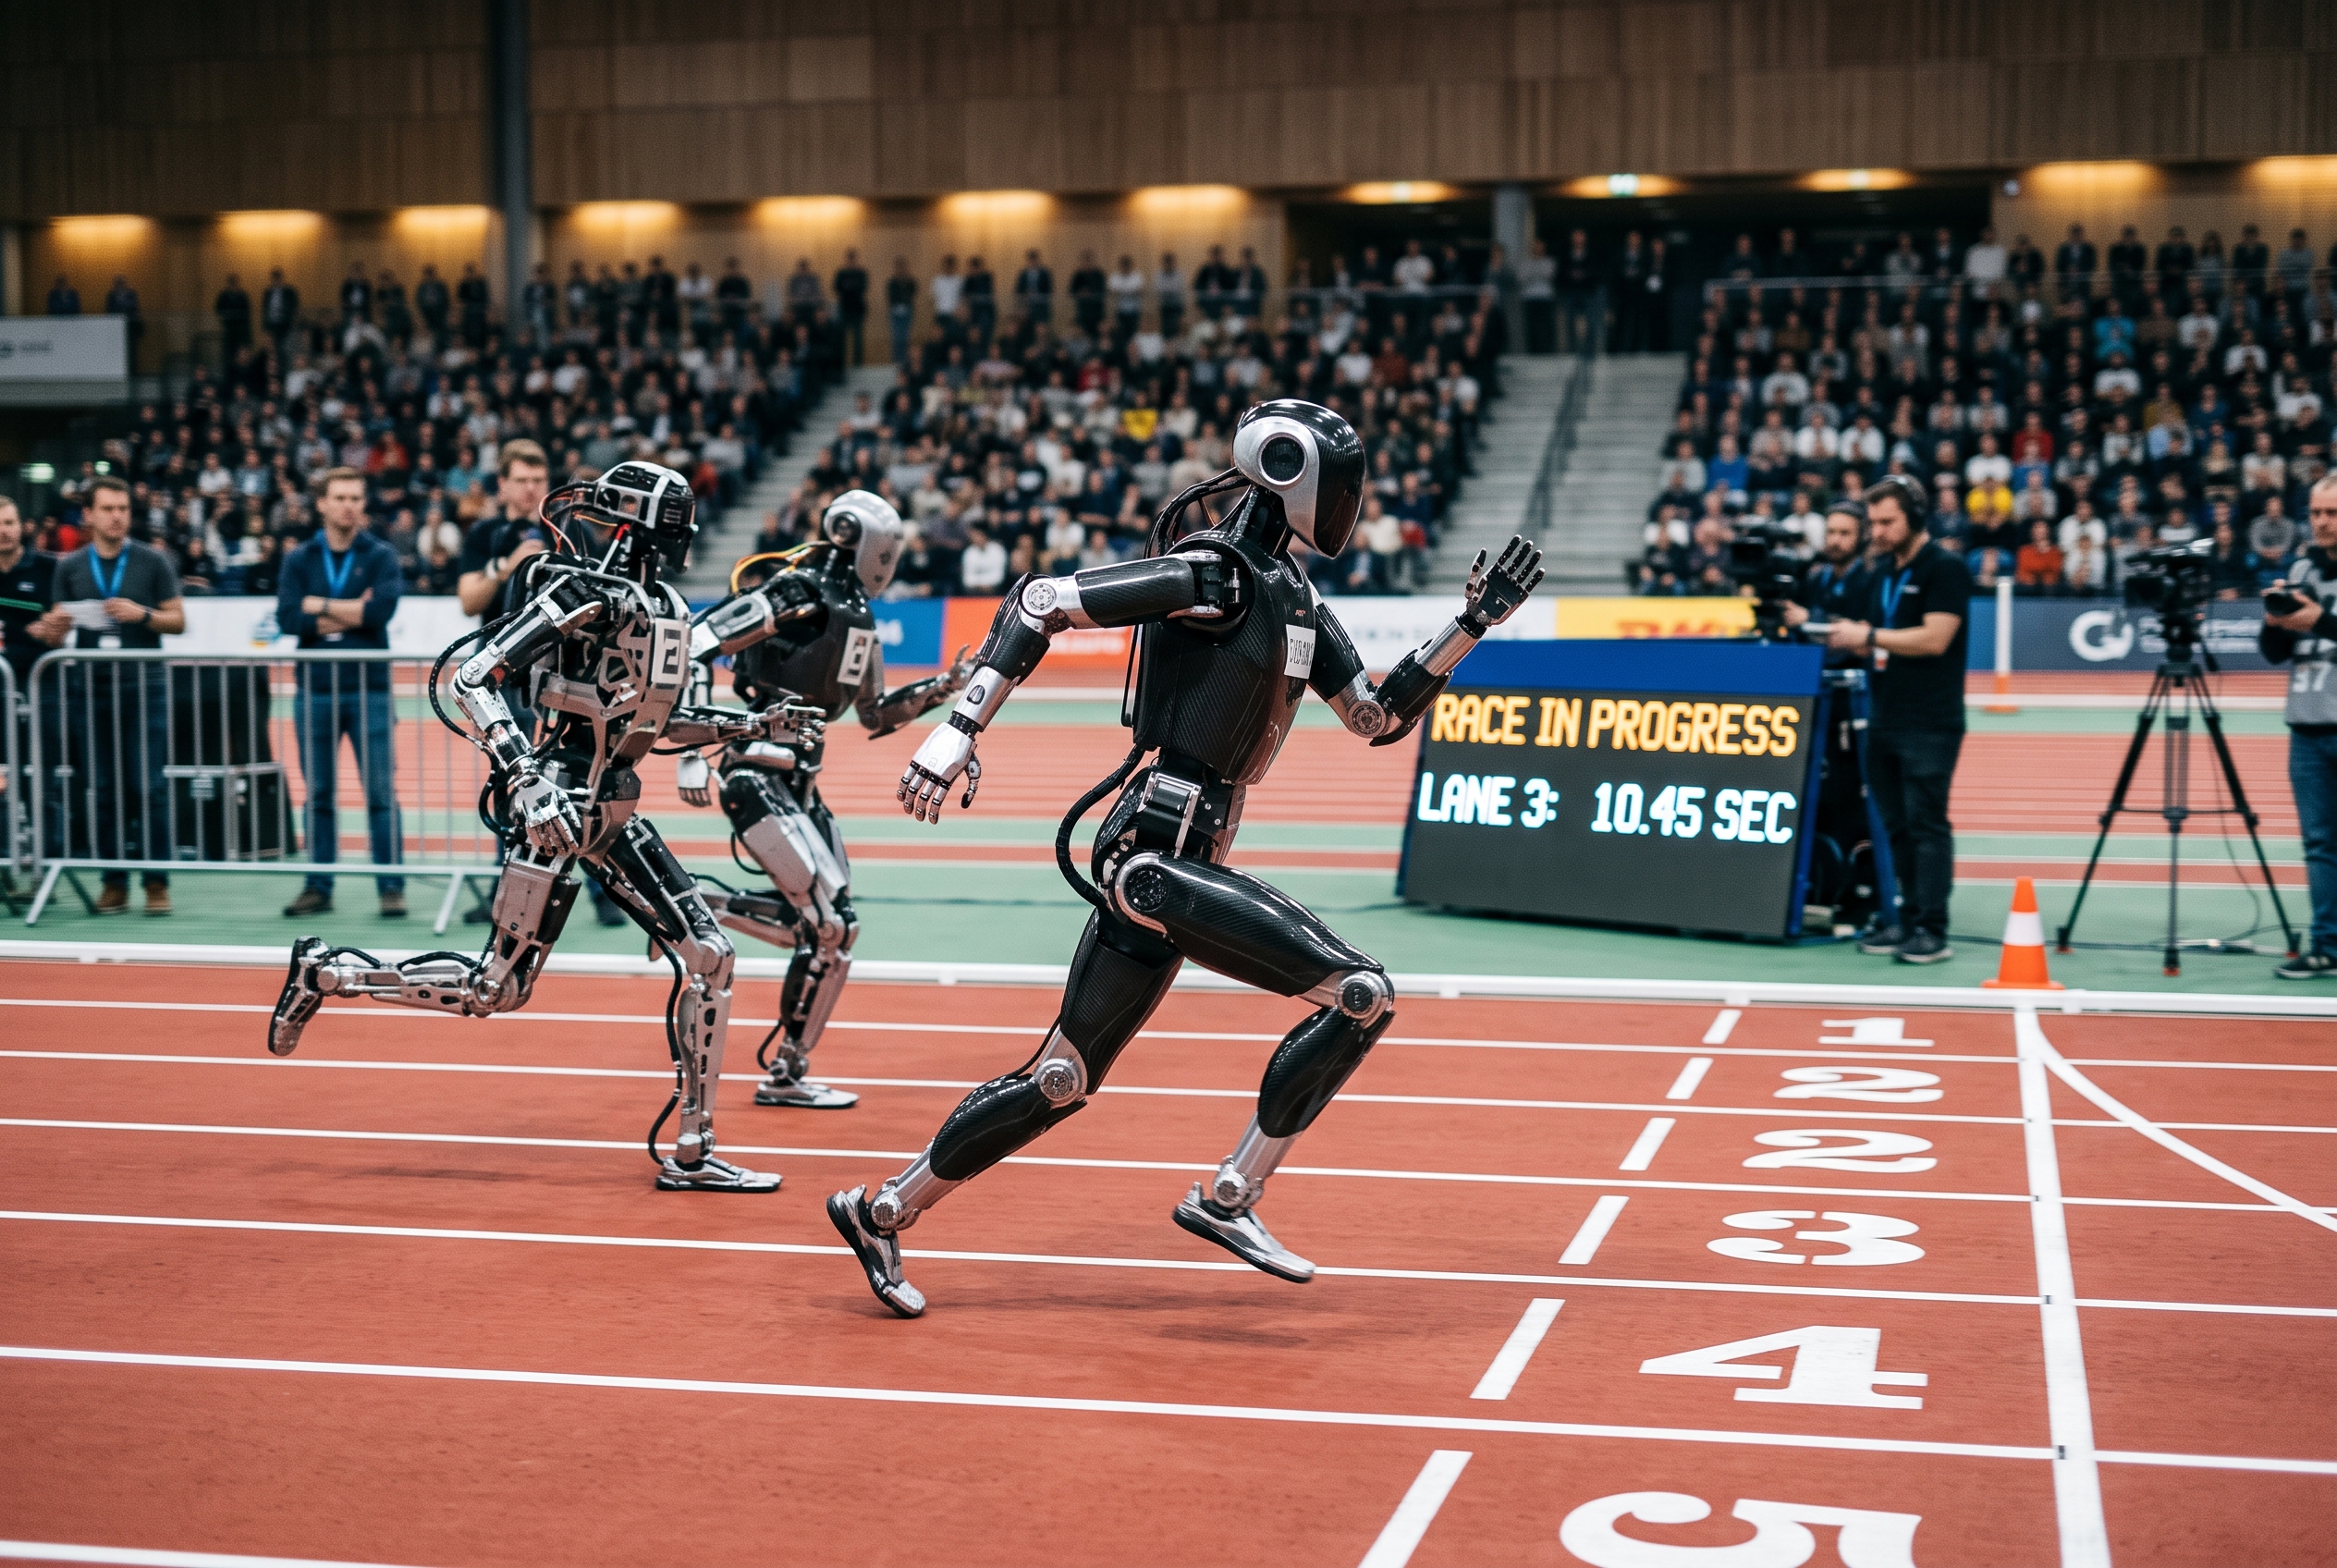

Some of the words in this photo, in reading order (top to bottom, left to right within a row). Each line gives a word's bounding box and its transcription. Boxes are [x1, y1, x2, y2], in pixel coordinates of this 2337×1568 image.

[1430, 693, 1531, 745] RACE
[1535, 697, 1582, 747] IN
[1586, 699, 1799, 756] PROGRESS
[1417, 772, 1516, 826] LANE
[1521, 778, 1560, 827] 3:
[1590, 782, 1706, 839] 10.45
[1711, 789, 1797, 843] SEC
[1817, 1017, 1935, 1047] 1
[1773, 1066, 1944, 1103] 2
[1741, 1129, 1939, 1173] 2
[1707, 1210, 1926, 1266] 3
[1638, 1326, 1928, 1410] 4
[1559, 1491, 1923, 1568] 5
